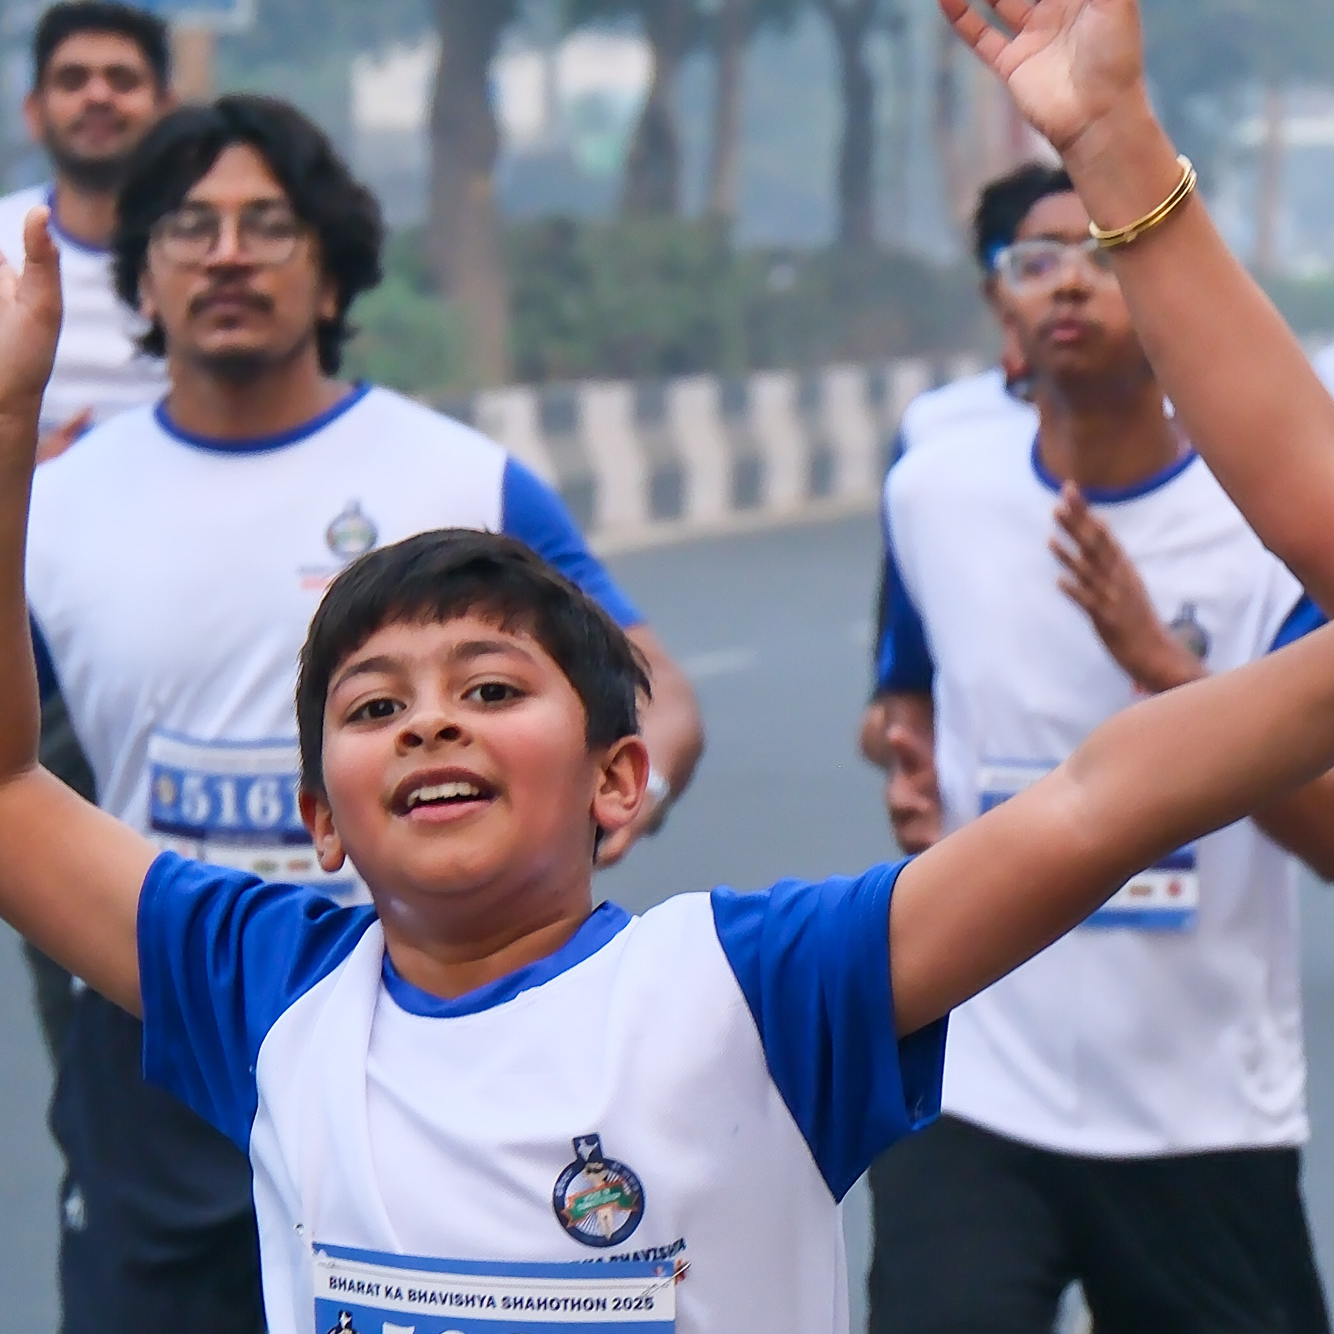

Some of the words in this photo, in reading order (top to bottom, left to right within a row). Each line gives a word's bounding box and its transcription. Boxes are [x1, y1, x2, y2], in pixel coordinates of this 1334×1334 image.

[181, 775, 301, 829] 516
[328, 1275, 381, 1297] BHARAT
[384, 1285, 403, 1301] KA
[407, 1288, 497, 1310] BHAVISHYA
[500, 1295, 607, 1312] SHAHOTHON
